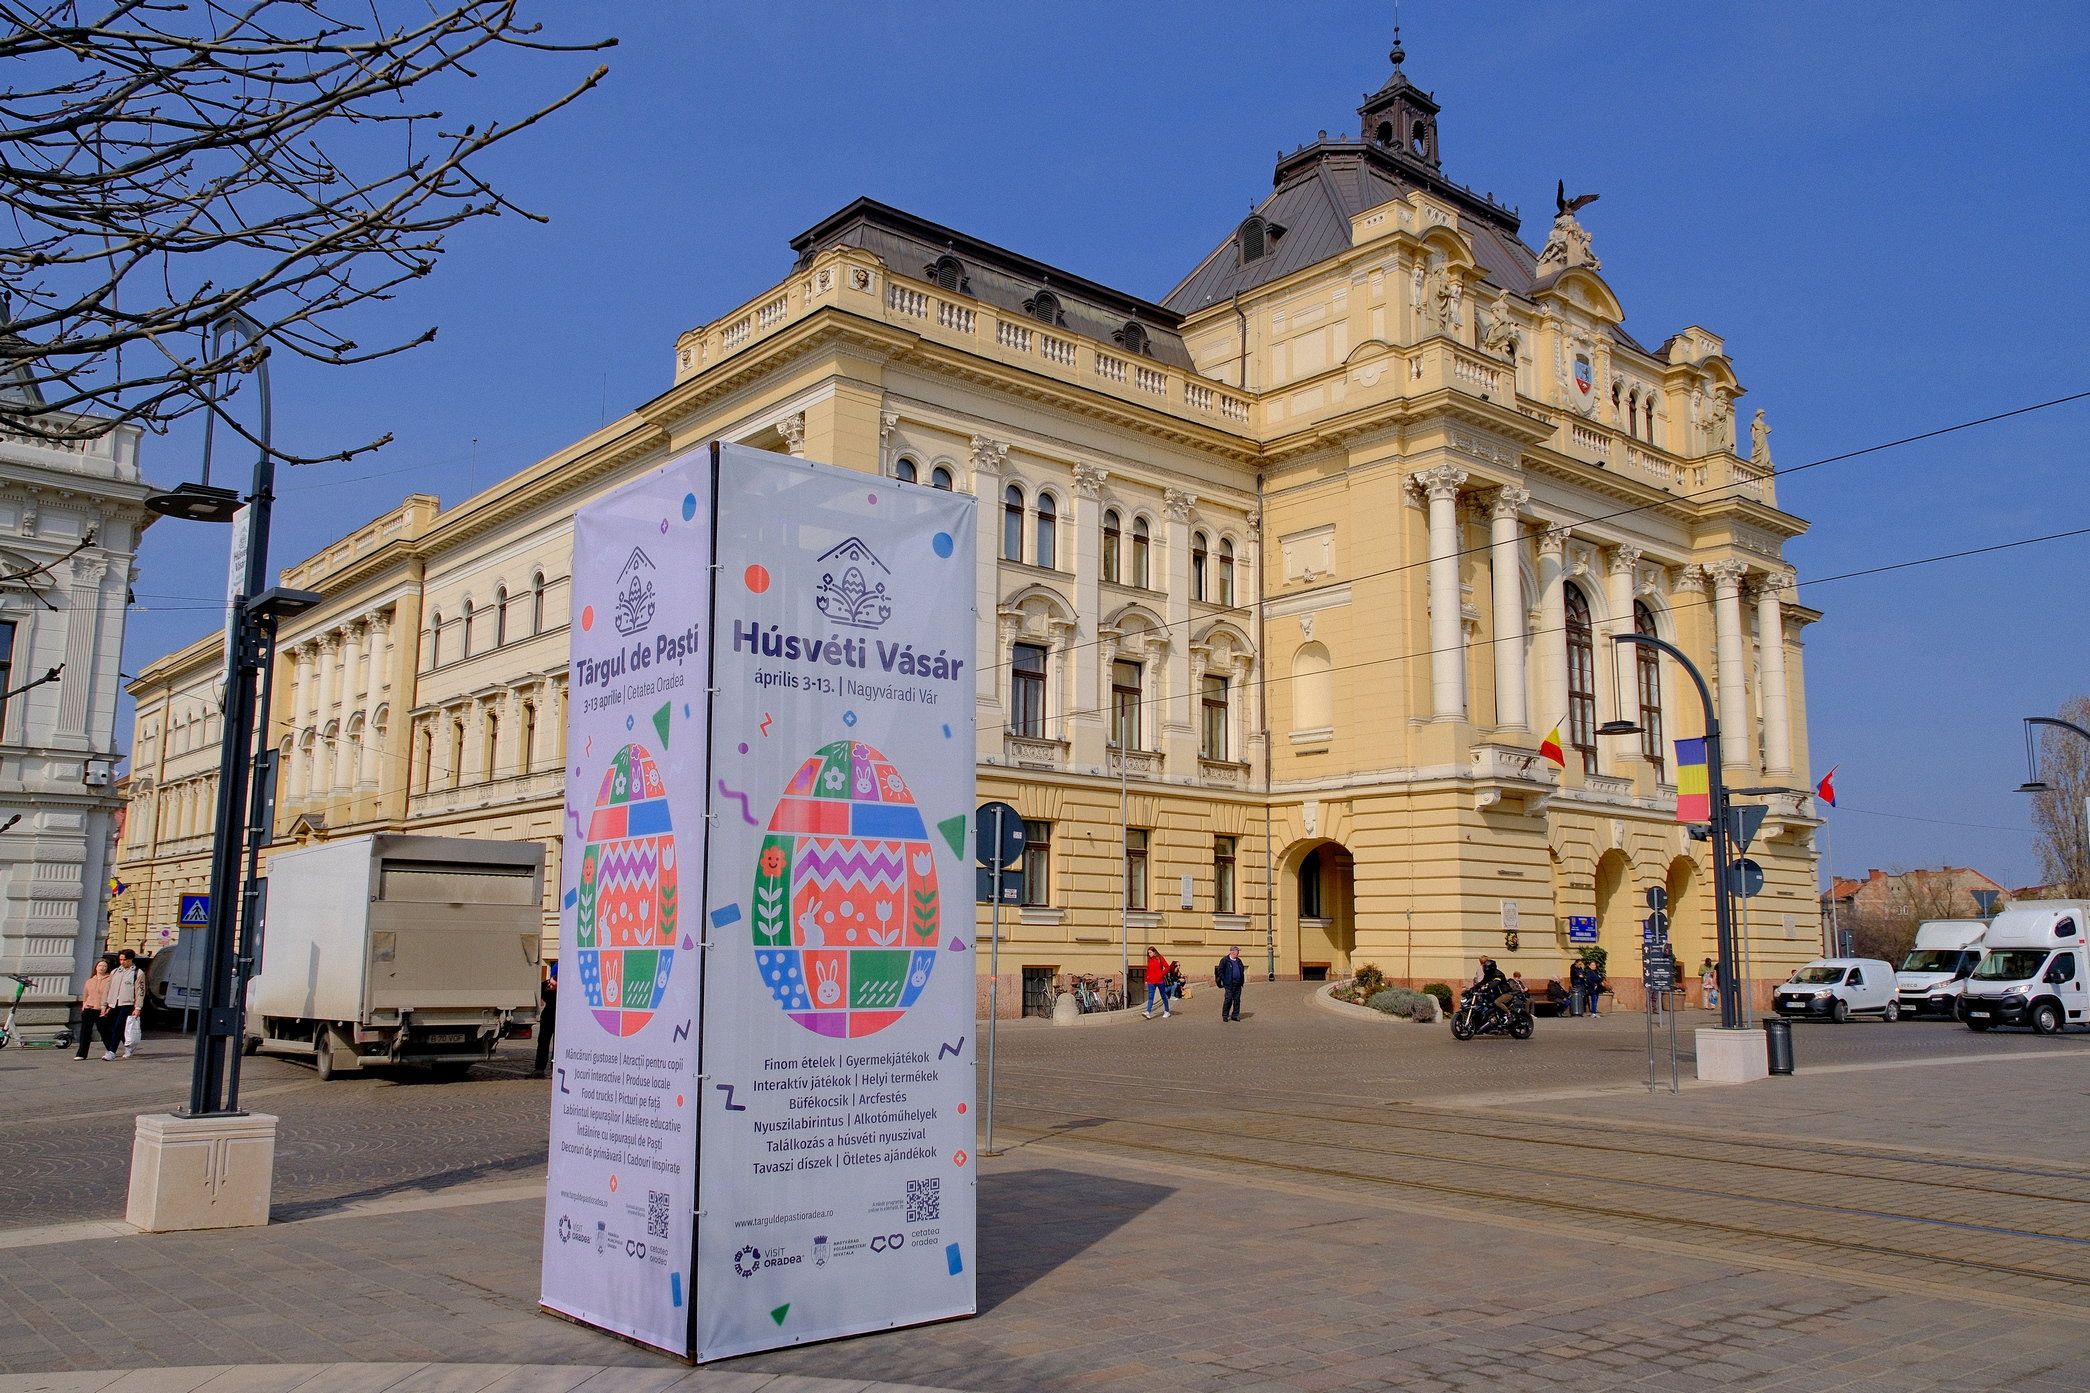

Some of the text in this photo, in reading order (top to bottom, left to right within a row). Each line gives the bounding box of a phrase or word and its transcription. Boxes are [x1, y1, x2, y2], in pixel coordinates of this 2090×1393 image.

[576, 623, 699, 688] Târgul de Paști
[733, 619, 964, 681] Húsvéti Vásár
[600, 689, 622, 711] aprilie
[627, 682, 655, 701] Cetatea
[657, 673, 684, 692] Oradea
[754, 668, 799, 689] április
[802, 676, 835, 693] 3-13.
[847, 680, 916, 702] Nagyváradi
[919, 688, 938, 705] Vár
[593, 1051, 618, 1064] gustoase
[645, 1058, 666, 1071] pentru
[667, 1058, 684, 1073] copii
[764, 1058, 798, 1071] Finom
[801, 1055, 836, 1068] ételek
[846, 1051, 930, 1068] Gyermekjátékok
[574, 1068, 590, 1080] Jocuri
[591, 1069, 621, 1084] interactive
[625, 1074, 650, 1087] Produse
[652, 1076, 671, 1090] locale
[753, 1077, 808, 1092] Interaktív
[810, 1075, 852, 1091] játékok
[862, 1072, 888, 1086] Helyi
[891, 1070, 939, 1084] termékek
[581, 1088, 595, 1100] Food
[595, 1089, 614, 1102] trucks
[618, 1092, 638, 1105] Picturi
[639, 1098, 647, 1109] pe
[789, 1095, 849, 1110] Büfékocsik
[859, 1091, 907, 1105] Arcfestés
[563, 1104, 590, 1117] Labirintul
[625, 1113, 649, 1128] Ateliere
[650, 1117, 681, 1133] educative
[754, 1115, 844, 1135] Nyuszilabirintus
[601, 1130, 609, 1140] cu
[637, 1134, 647, 1147] de
[766, 1128, 926, 1152] Találkozás a húsvéti nyuszival
[561, 1141, 585, 1154] Decoruri
[584, 1144, 593, 1157] de
[627, 1153, 651, 1168] Cadouri
[651, 1157, 681, 1174] inspirate
[753, 1158, 794, 1175] Tavaszi
[797, 1155, 832, 1170] díszek
[843, 1151, 882, 1166] Ötletes
[884, 1146, 937, 1164] ajándékok
[734, 1209, 834, 1228] www.targuldepastioradea.ro
[911, 1228, 940, 1238] cetatea
[911, 1237, 938, 1247] oradea
